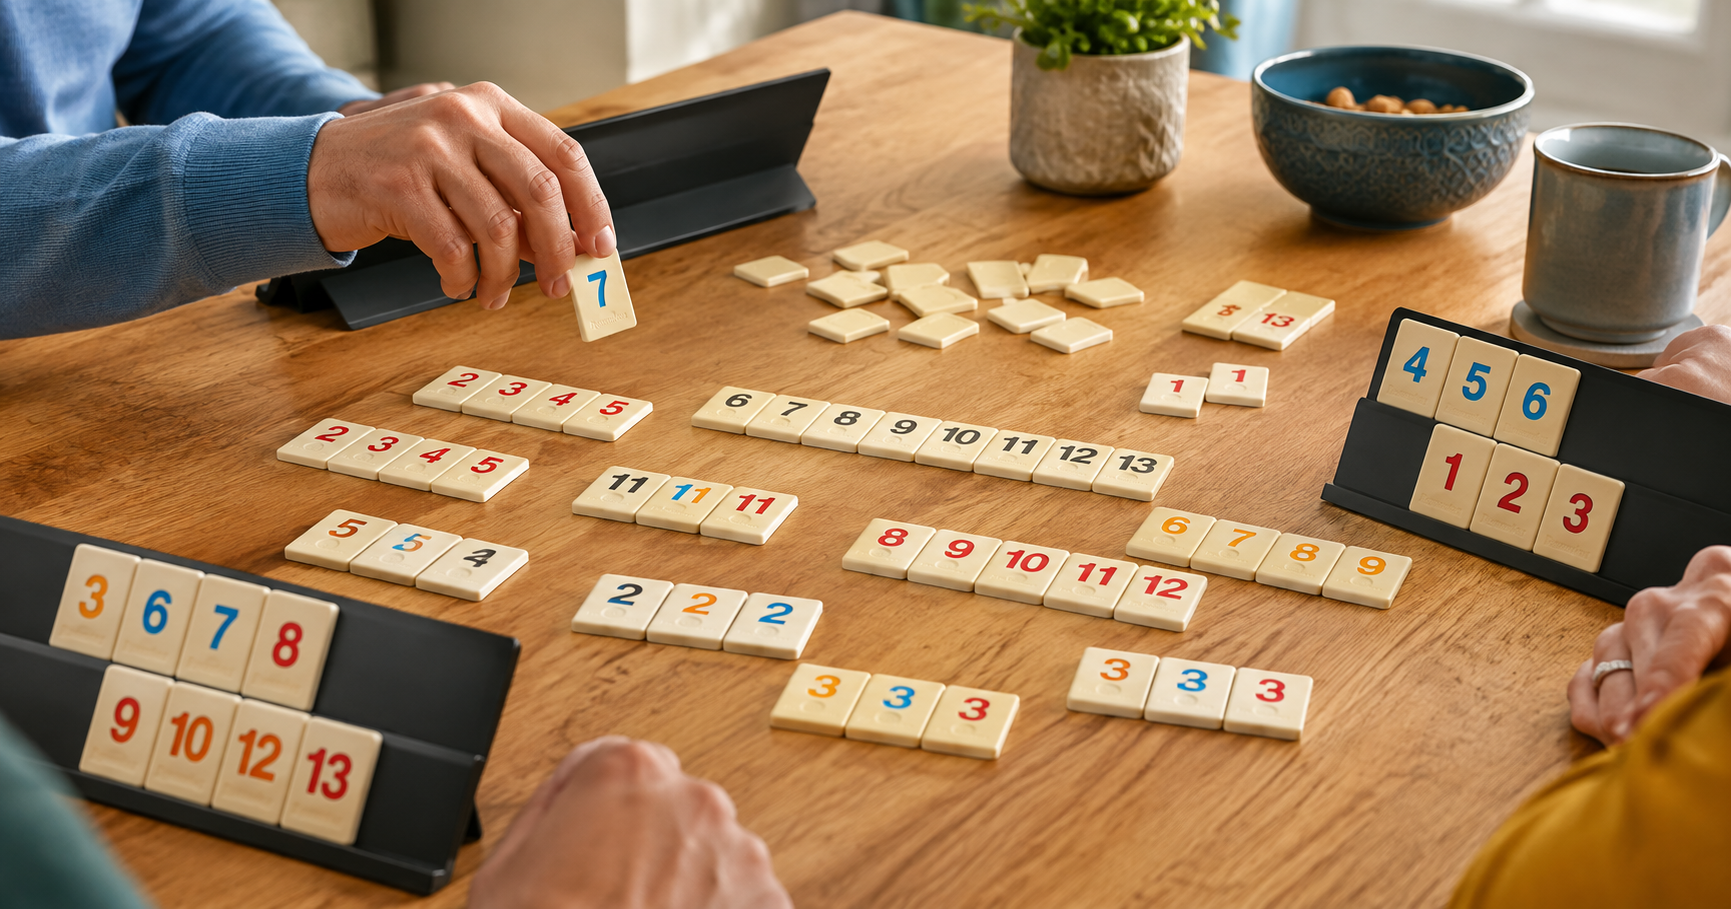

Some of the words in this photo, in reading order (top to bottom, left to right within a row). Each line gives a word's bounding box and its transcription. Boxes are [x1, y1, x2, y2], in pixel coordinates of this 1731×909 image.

[587, 270, 607, 307] 7
[1262, 313, 1294, 327] 13
[447, 372, 479, 388] 2
[498, 382, 527, 396] 3
[548, 392, 577, 406] 4
[599, 400, 629, 416] 5
[1171, 380, 1184, 393] 1
[1232, 370, 1246, 382] 1
[1403, 347, 1429, 383] 4
[1462, 362, 1491, 401] 5
[1523, 382, 1550, 420] 6
[315, 425, 349, 442] 2
[367, 436, 399, 452] 3
[419, 447, 451, 464] 4
[470, 456, 504, 474] 5
[725, 393, 753, 409] 6
[779, 401, 808, 417] 7
[833, 410, 861, 426] 8
[889, 419, 917, 435] 9
[943, 427, 981, 445] 10
[1002, 436, 1039, 454] 11
[1059, 444, 1098, 465] 12
[1117, 454, 1157, 474] 13
[609, 474, 649, 493] 11
[672, 484, 711, 503] 11
[736, 494, 775, 514] 11
[1444, 453, 1463, 491] 1
[1497, 472, 1528, 513] 2
[1563, 493, 1593, 533] 3
[328, 518, 367, 539] 5
[392, 533, 432, 552] 5
[1162, 517, 1190, 534] 6
[1228, 529, 1256, 547] 7
[1290, 544, 1319, 561] 8
[1357, 557, 1386, 575] 9
[878, 528, 908, 546] 8
[945, 540, 974, 558] 9
[1006, 550, 1049, 572] 10
[1078, 563, 1117, 586] 11
[1144, 575, 1188, 600] 12
[79, 575, 107, 618] 3
[143, 590, 171, 634] 6
[210, 605, 238, 649] 7
[272, 622, 302, 667] 8
[607, 583, 643, 606] 2
[683, 593, 717, 615] 2
[759, 603, 793, 625] 2
[808, 675, 841, 698] 3
[883, 686, 915, 709] 3
[959, 698, 990, 721] 3
[1100, 658, 1131, 681] 3
[1177, 669, 1208, 691] 3
[1256, 679, 1285, 702] 3
[111, 697, 140, 743] 9
[170, 713, 213, 761] 10
[238, 730, 281, 781] 12
[307, 749, 351, 800] 13
